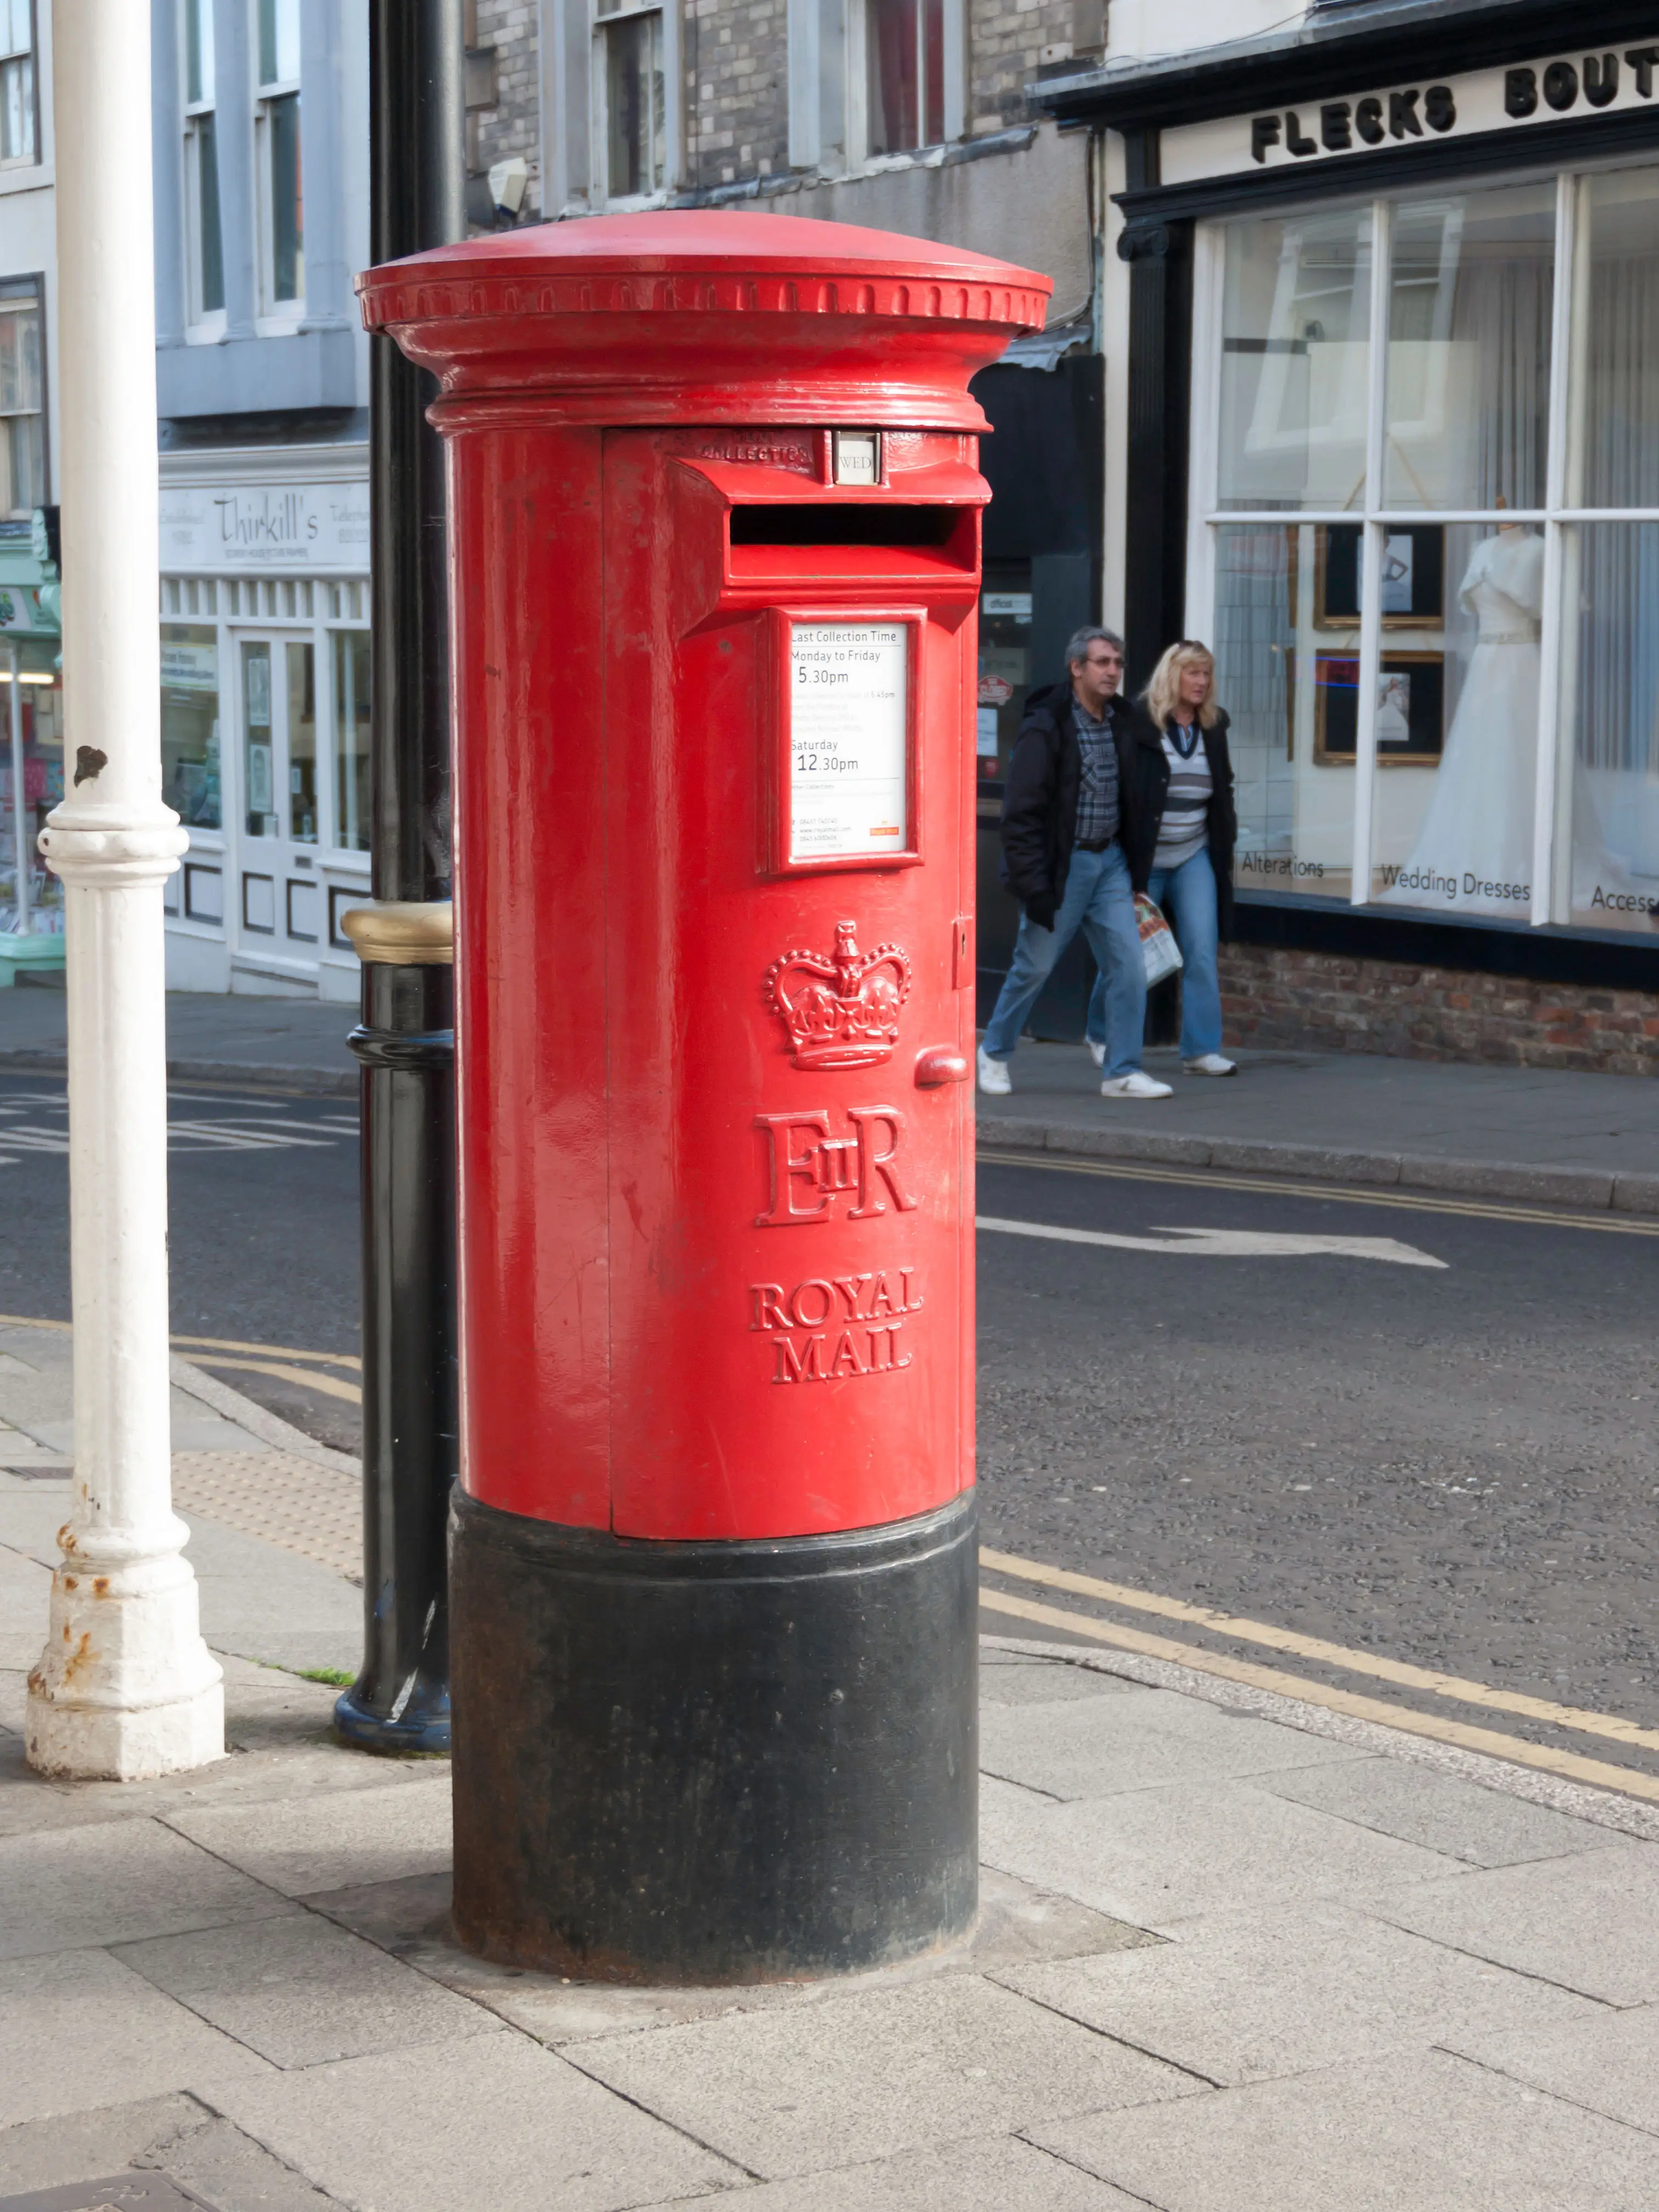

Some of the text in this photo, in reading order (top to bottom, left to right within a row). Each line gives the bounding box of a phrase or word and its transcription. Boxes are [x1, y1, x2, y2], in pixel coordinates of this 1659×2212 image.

[1252, 46, 1659, 164] FLECKS BOUT
[702, 443, 812, 463] COLLECTION
[839, 456, 872, 469] WED
[213, 493, 318, 544] Thirkill's
[817, 631, 867, 642] Collection
[871, 631, 896, 641] Time
[792, 650, 880, 663] Monday to Friday
[798, 666, 848, 685] 5.30pm
[792, 740, 838, 752] Saturday
[797, 754, 858, 773] 12.30pm
[1241, 851, 1324, 878] Alterations
[1381, 863, 1531, 901] Wedding Dresses
[749, 1267, 924, 1332] ROYAL
[771, 1322, 913, 1384] MAIL
